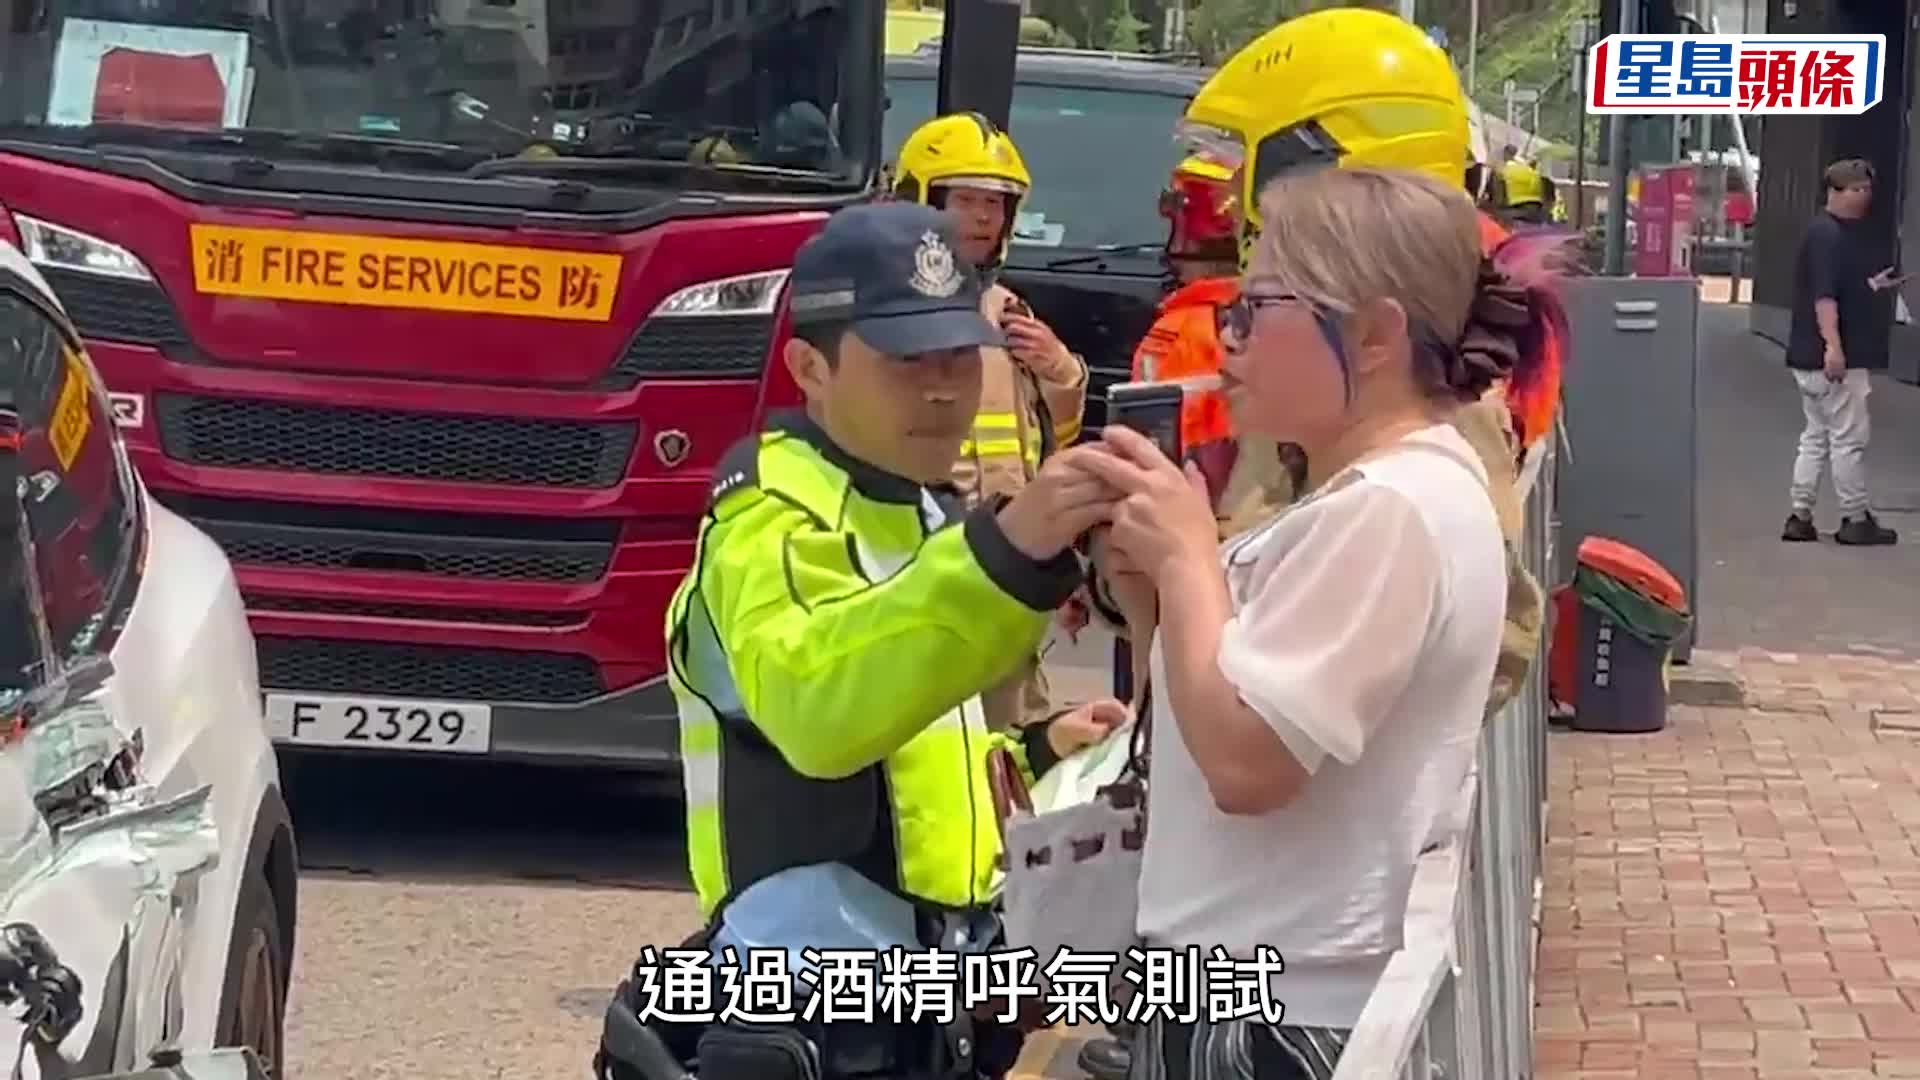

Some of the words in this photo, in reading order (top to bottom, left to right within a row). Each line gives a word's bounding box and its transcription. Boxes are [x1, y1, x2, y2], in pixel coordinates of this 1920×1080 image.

[205, 239, 244, 283] 消
[261, 246, 346, 286] FIRE
[357, 253, 541, 301] SERVICES
[558, 265, 603, 309] 防
[292, 702, 321, 737] F
[344, 706, 464, 744] 2329
